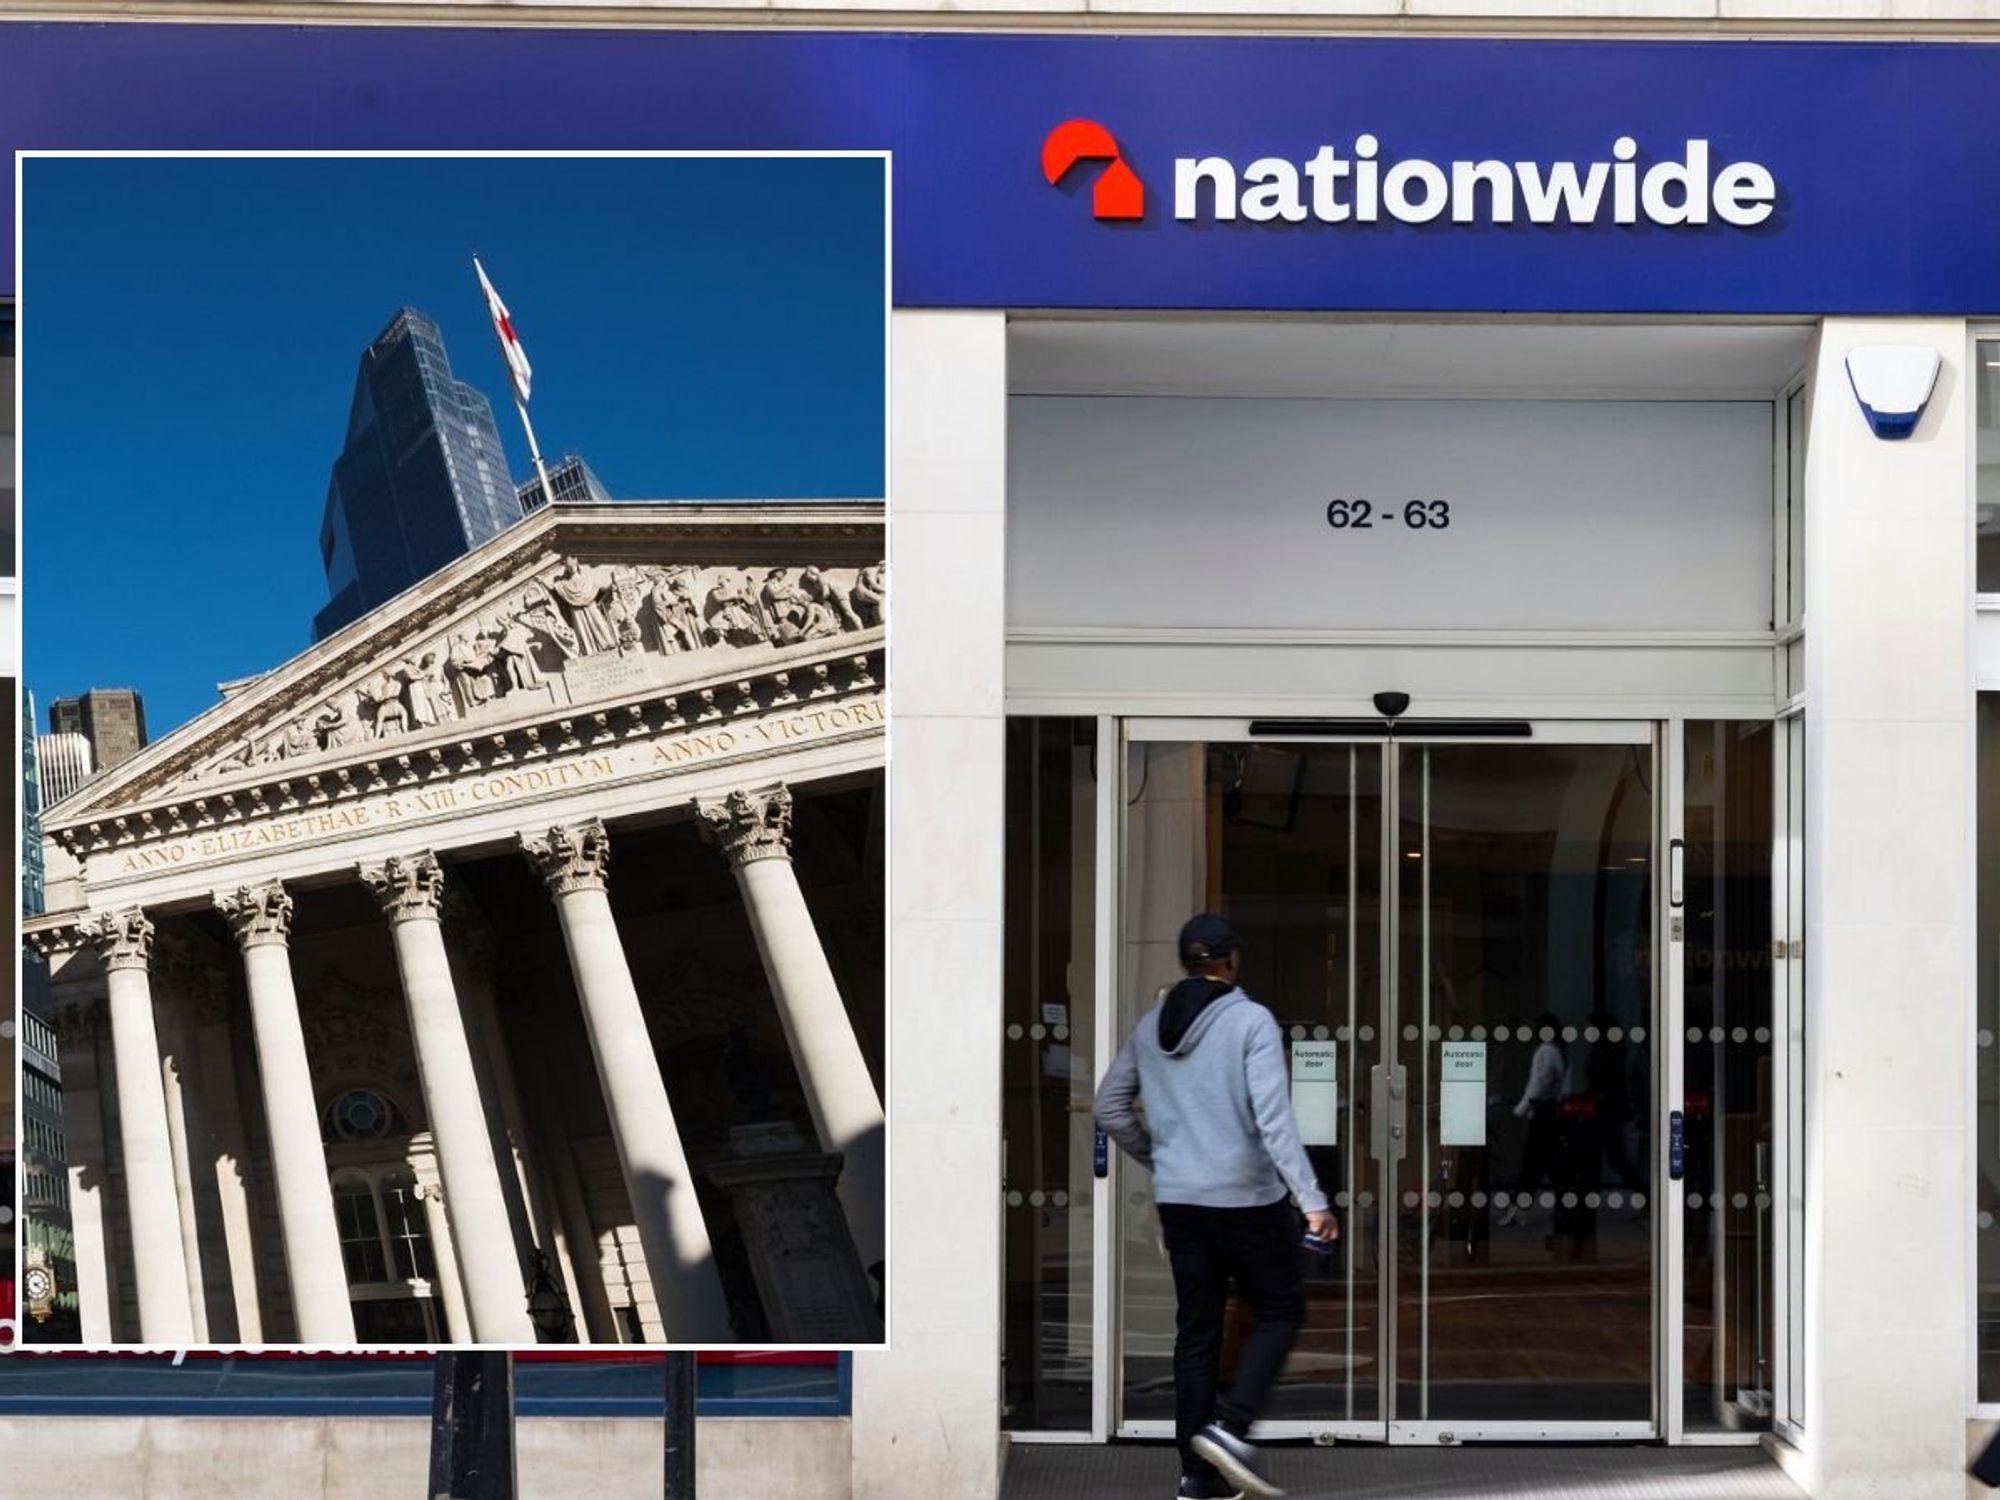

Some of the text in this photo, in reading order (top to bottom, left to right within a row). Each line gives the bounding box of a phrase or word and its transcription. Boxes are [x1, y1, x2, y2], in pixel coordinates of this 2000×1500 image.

[1174, 134, 1777, 226] nationwide
[1327, 499, 1373, 528] 62
[1404, 500, 1450, 529] 63
[122, 845, 185, 873] ANNO
[201, 806, 370, 857] ELIZABETHAE
[415, 788, 458, 812] XIII
[471, 756, 614, 802] CONDITVM
[652, 731, 736, 765] ANNO
